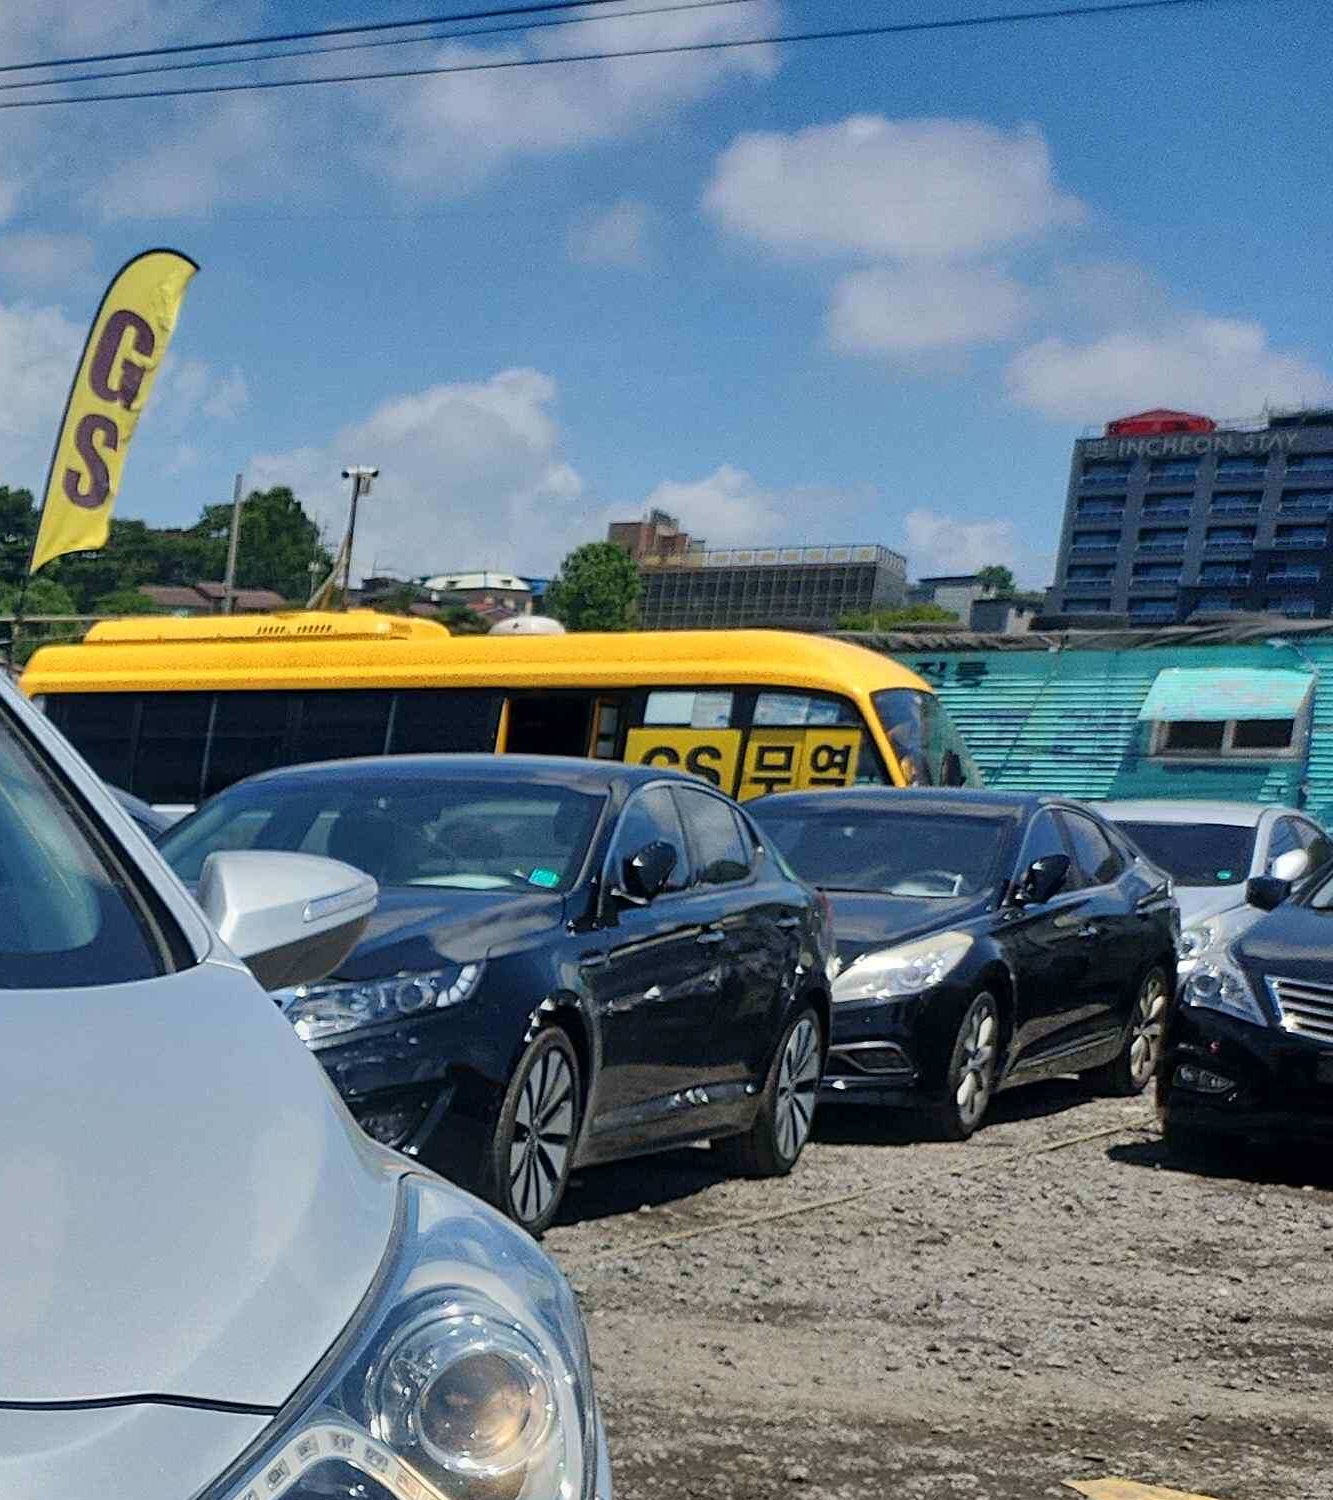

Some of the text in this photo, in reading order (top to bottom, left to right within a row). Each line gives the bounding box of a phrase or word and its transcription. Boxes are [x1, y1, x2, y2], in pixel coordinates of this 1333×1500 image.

[63, 309, 155, 510] GS
[1118, 436, 1232, 456] INCHEON
[1244, 432, 1298, 451] STAY
